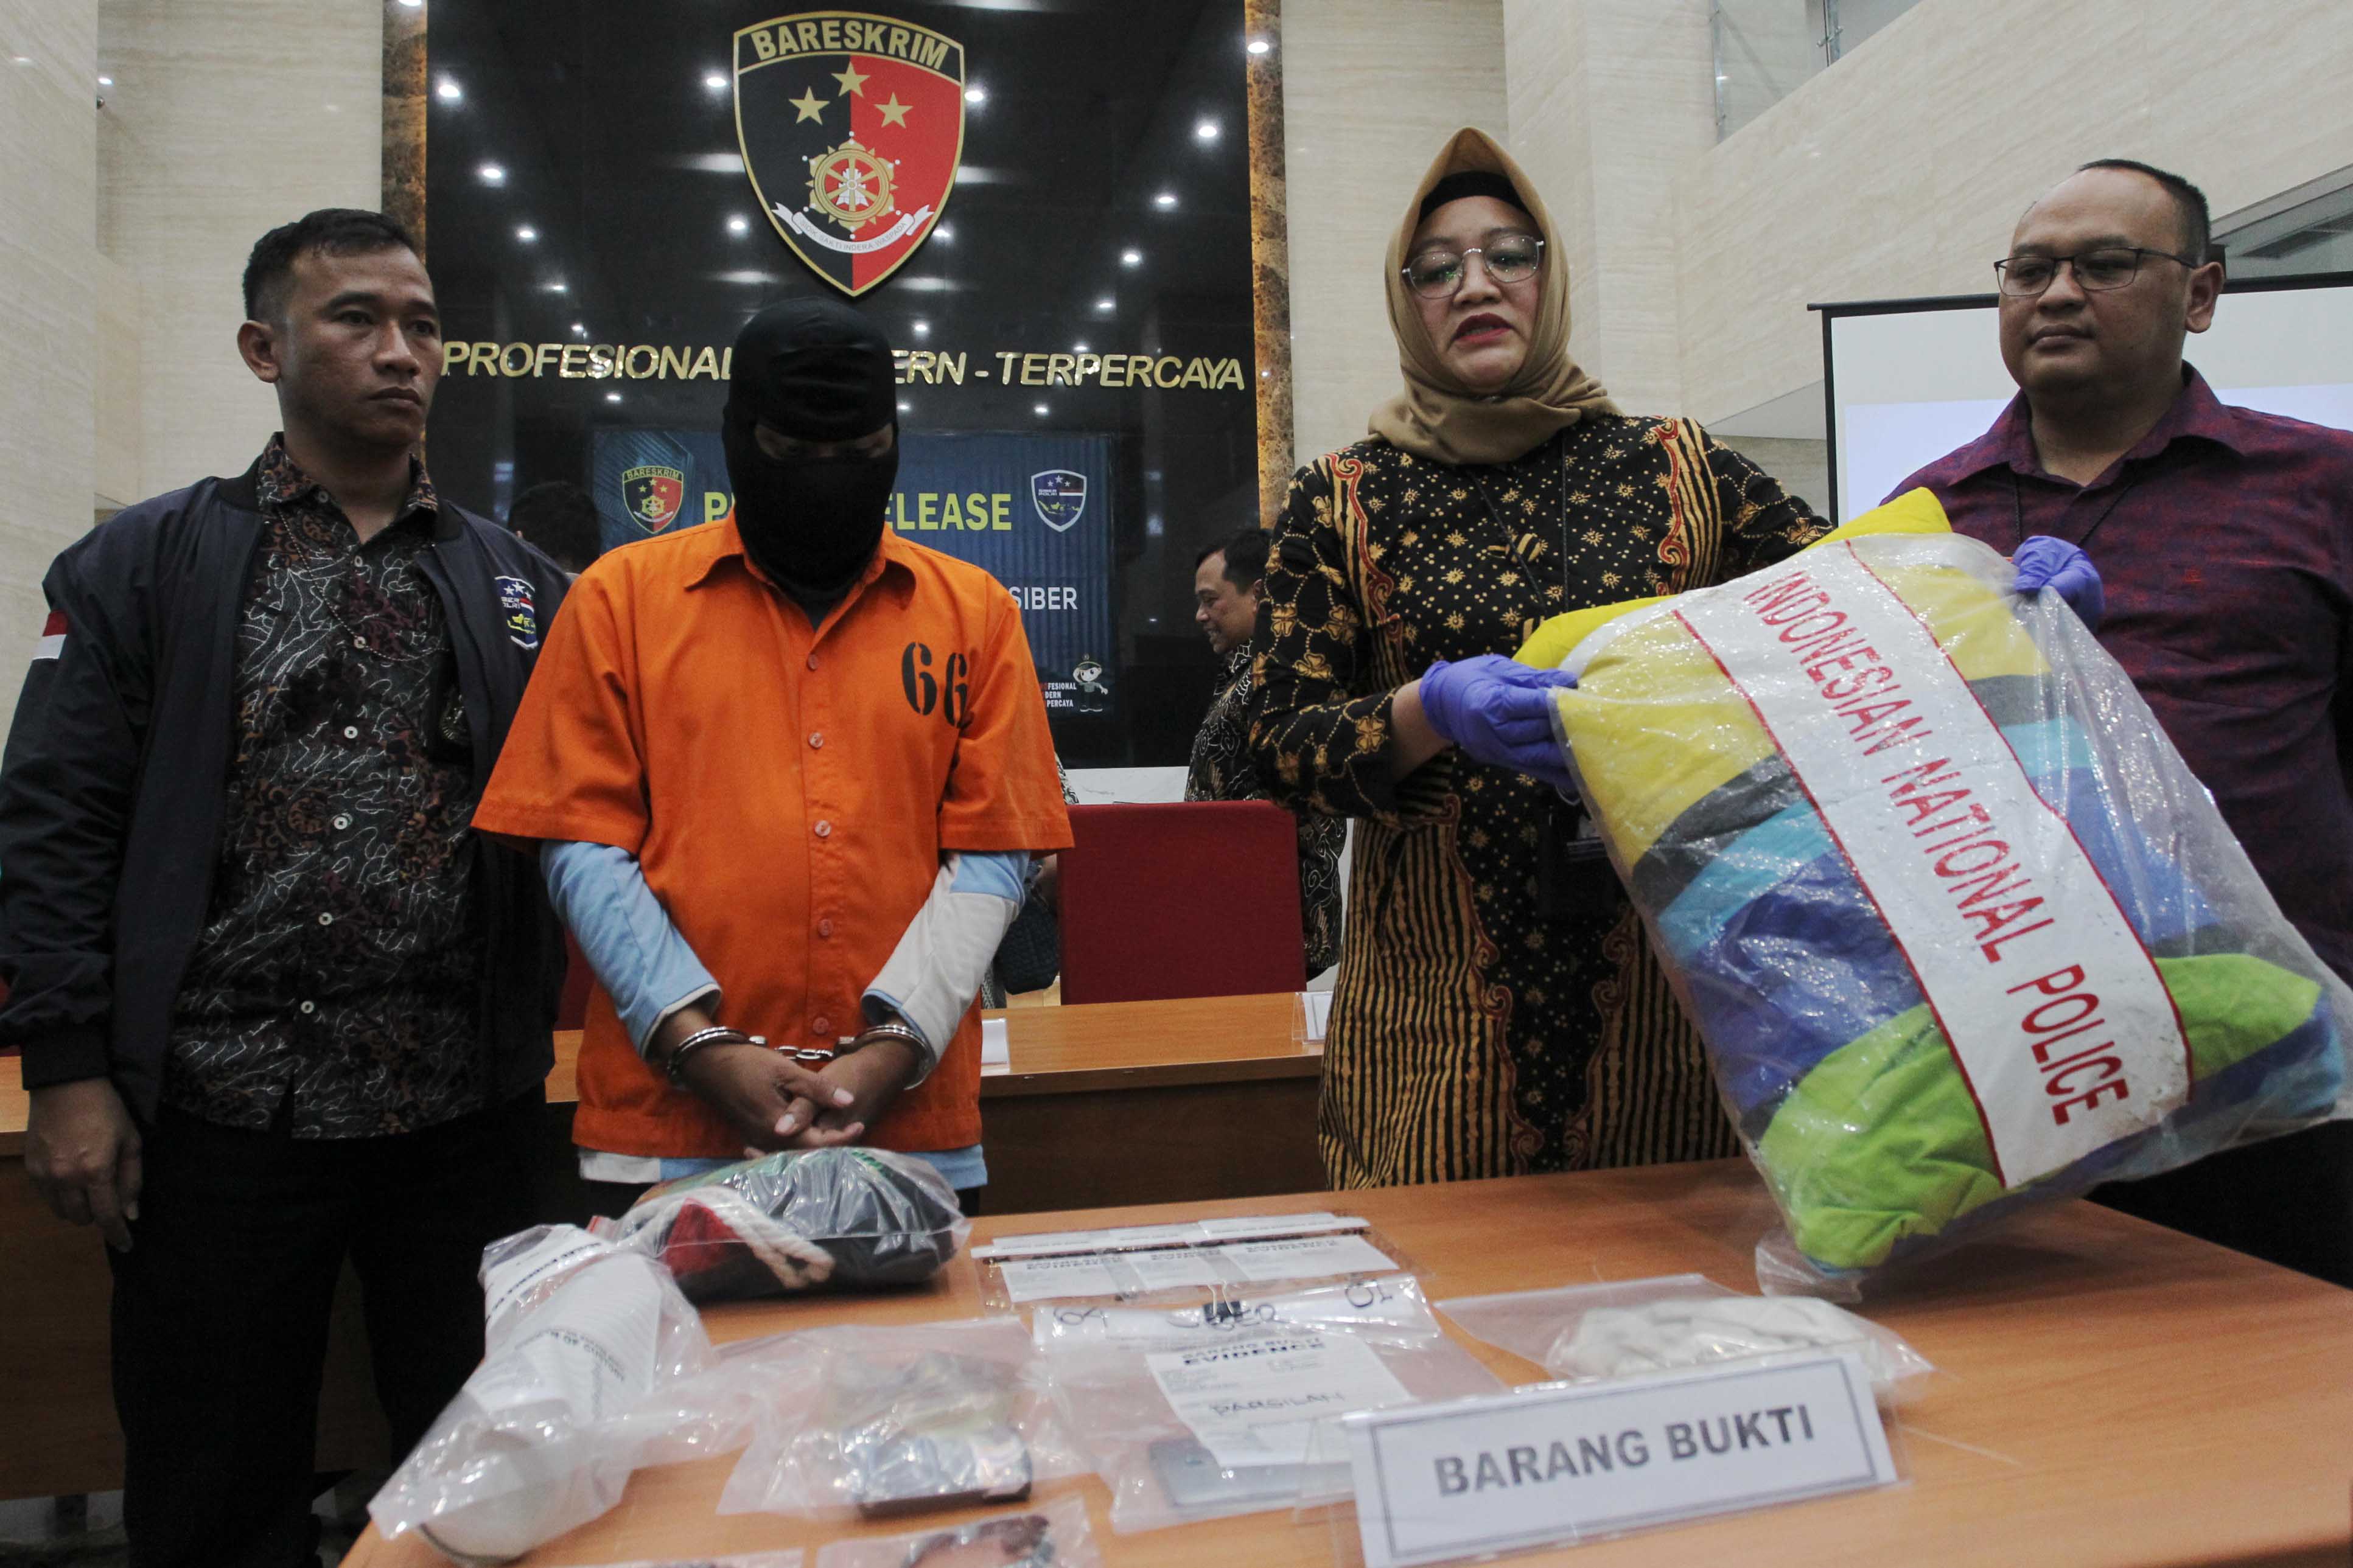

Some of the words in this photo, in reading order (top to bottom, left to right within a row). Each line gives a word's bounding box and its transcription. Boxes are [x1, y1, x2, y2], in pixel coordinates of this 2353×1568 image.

[751, 20, 949, 71] BARESKRIM
[441, 341, 732, 380] PROFESIONAL
[996, 352, 1245, 390] TERPERCAYA
[627, 468, 679, 479] BARESKRIM
[1009, 586, 1078, 610] SIBER
[901, 642, 974, 730] 66
[1044, 691, 1061, 699] DERN
[1046, 699, 1074, 708] PERCAYA
[1743, 570, 1932, 756] INDONESIAN
[1881, 758, 2055, 964] NATIONAL
[2005, 963, 2130, 1126] POLICE
[1184, 1343, 1326, 1365] EVIDENCE
[1433, 1429, 1651, 1497] BARANG
[1663, 1404, 1815, 1461] BUKTI
